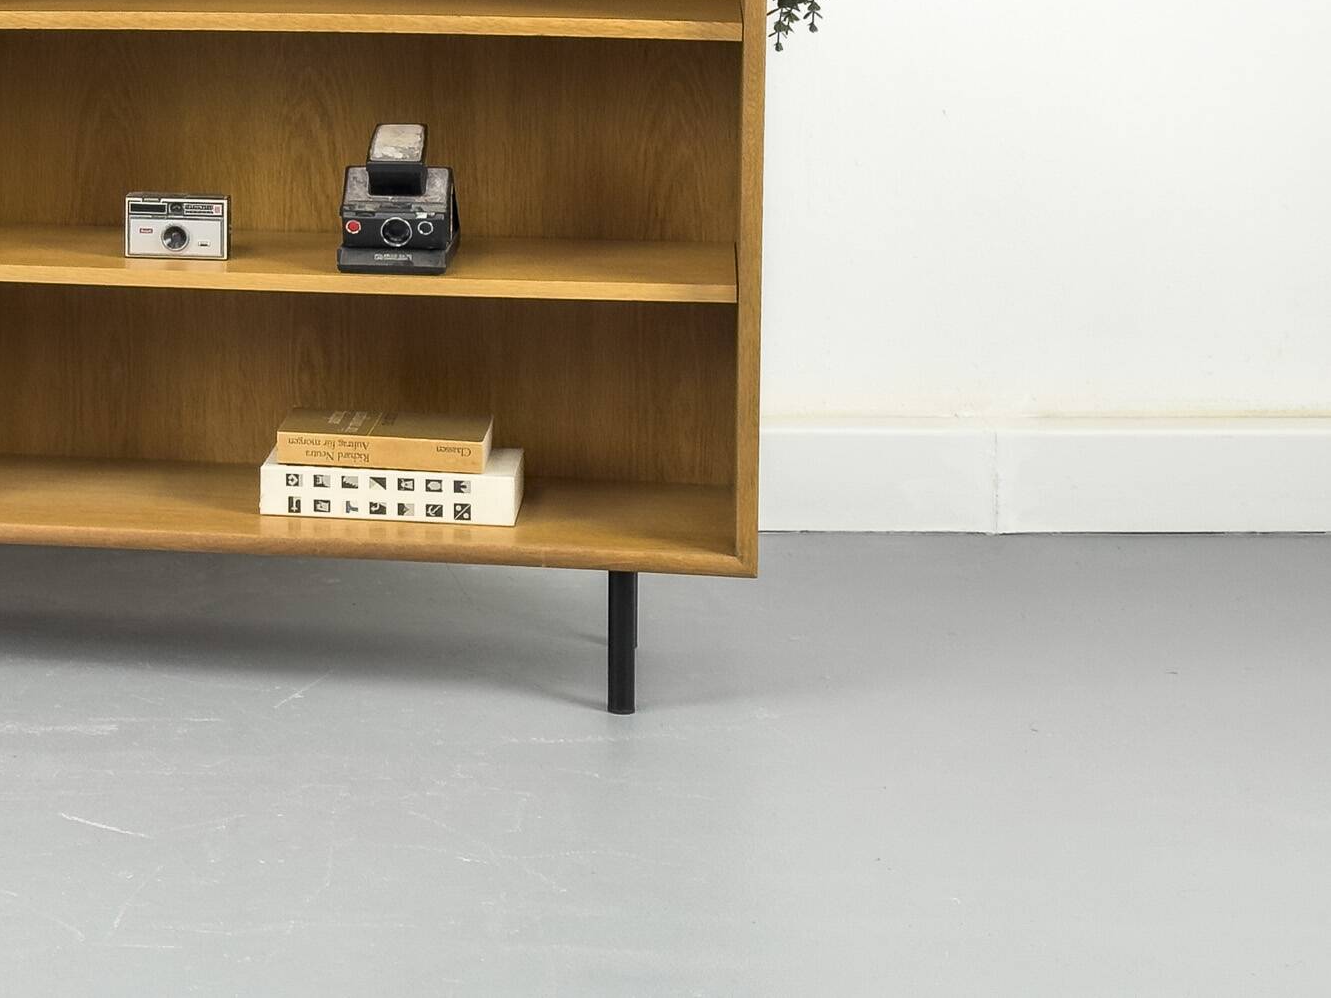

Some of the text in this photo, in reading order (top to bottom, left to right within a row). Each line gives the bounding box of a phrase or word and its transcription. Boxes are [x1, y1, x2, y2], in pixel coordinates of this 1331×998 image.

[288, 437, 370, 451] Auftrag für morgen
[305, 451, 370, 463] Richard Neutra
[436, 446, 472, 457] Claassen
